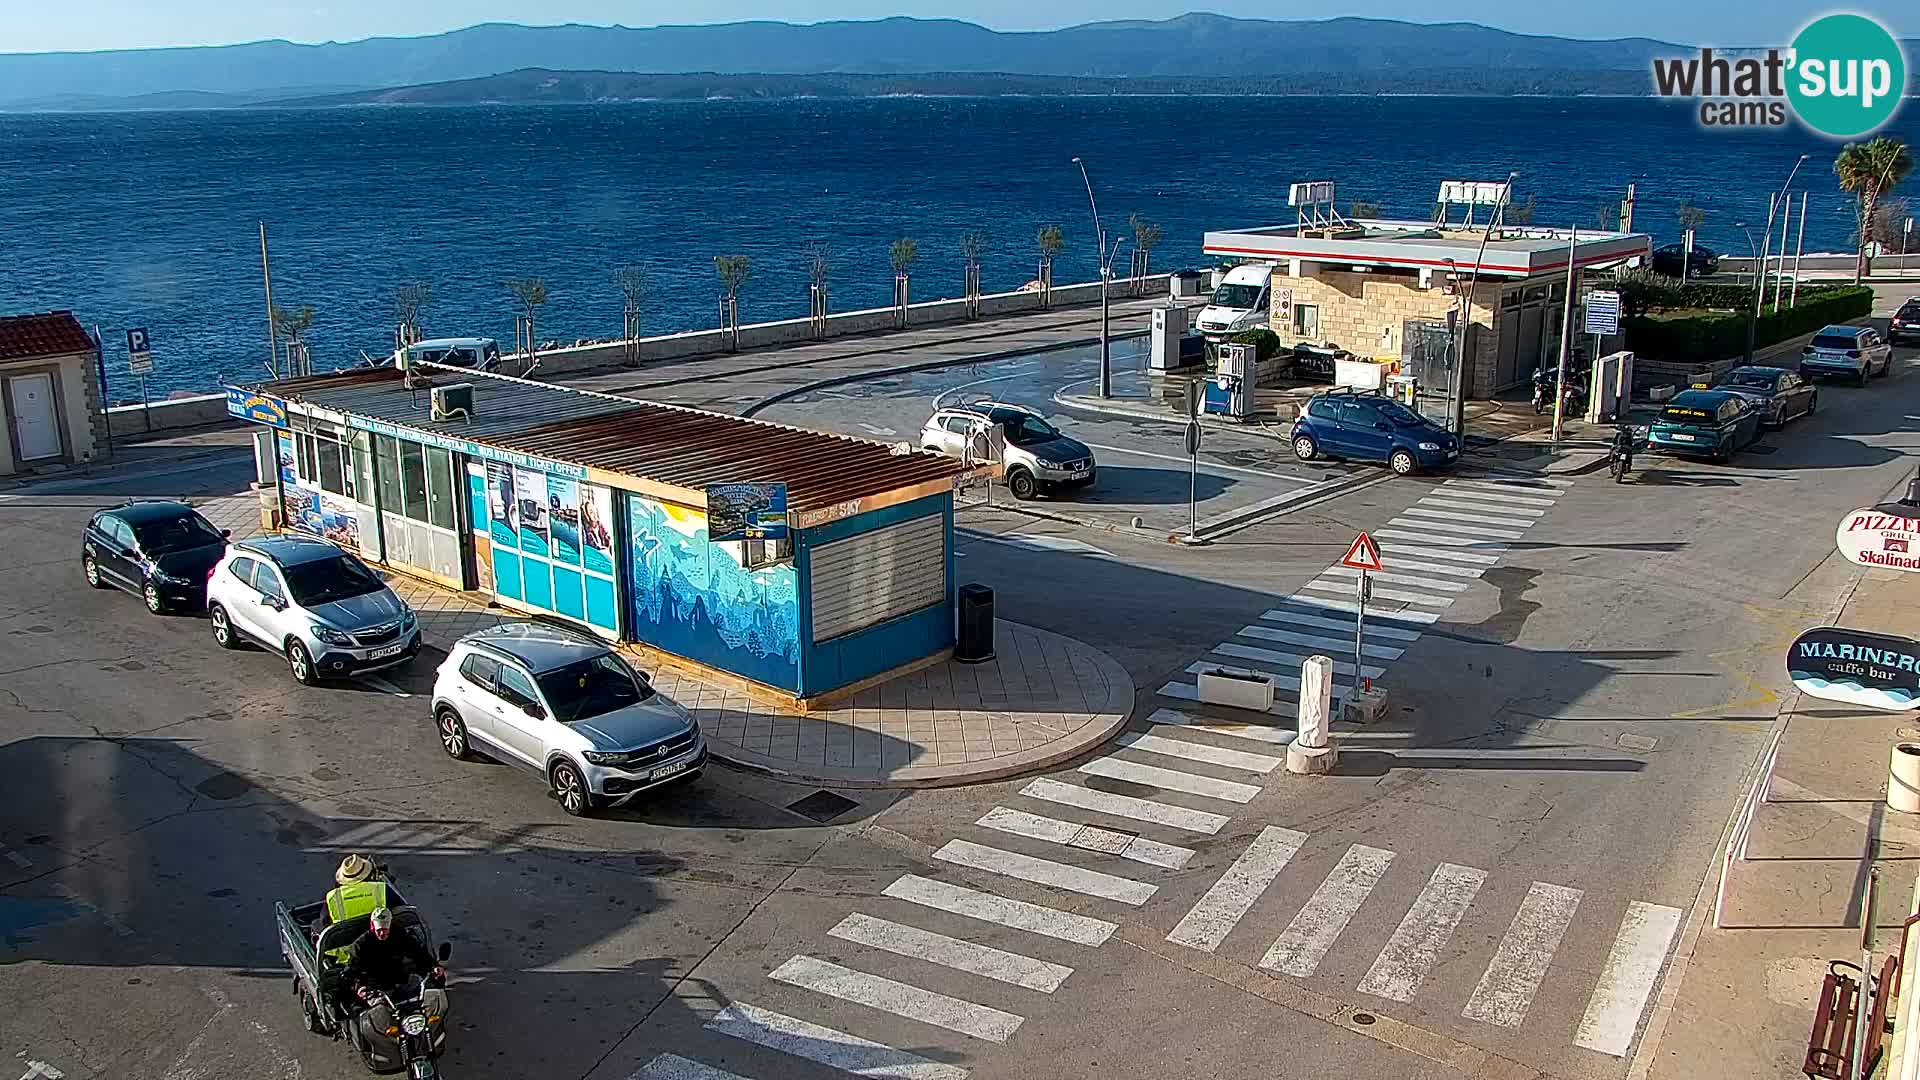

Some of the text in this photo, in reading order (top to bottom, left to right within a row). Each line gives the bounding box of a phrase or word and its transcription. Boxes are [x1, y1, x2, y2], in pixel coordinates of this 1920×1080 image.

[131, 331, 144, 349] P
[478, 446, 494, 458] BUS
[494, 449, 527, 465] STATION
[528, 456, 555, 471] TICKET
[555, 462, 583, 477] OFFICE
[1881, 530, 1917, 541] GRILL
[1827, 662, 1896, 681] caffe bar
